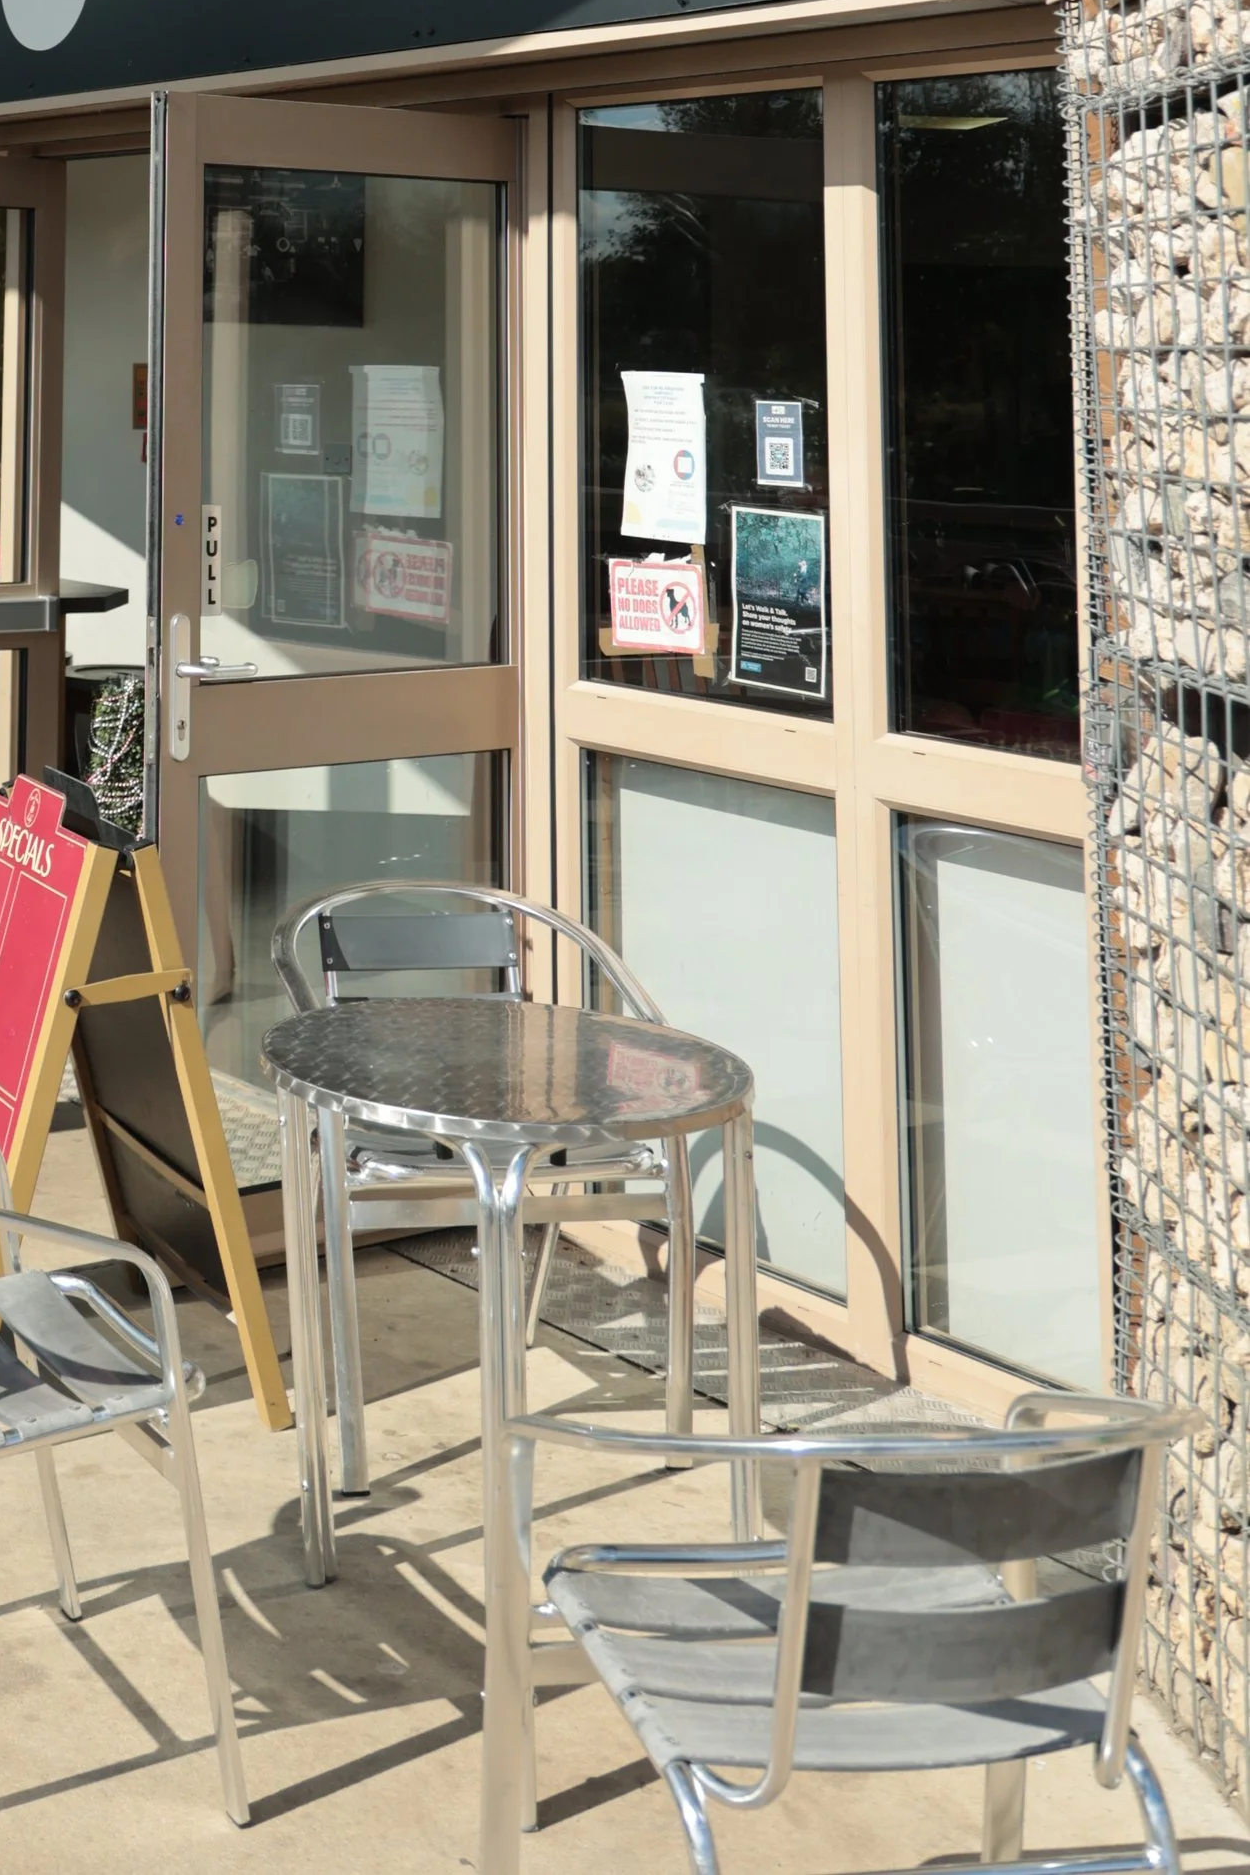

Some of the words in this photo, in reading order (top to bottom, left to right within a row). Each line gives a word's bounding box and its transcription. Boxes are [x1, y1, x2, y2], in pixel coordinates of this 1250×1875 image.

[763, 416, 779, 424] SCAN
[779, 416, 795, 425] HERE
[206, 516, 218, 605] PULL
[617, 577, 659, 597] PLEASE
[618, 597, 632, 612] NO
[633, 598, 658, 614] DOGS
[742, 603, 755, 611] Let's
[755, 605, 769, 613] Walk
[619, 615, 661, 632] ALLOWED
[742, 610, 757, 619] Share
[771, 615, 796, 625] thoughts
[750, 621, 774, 630] women's
